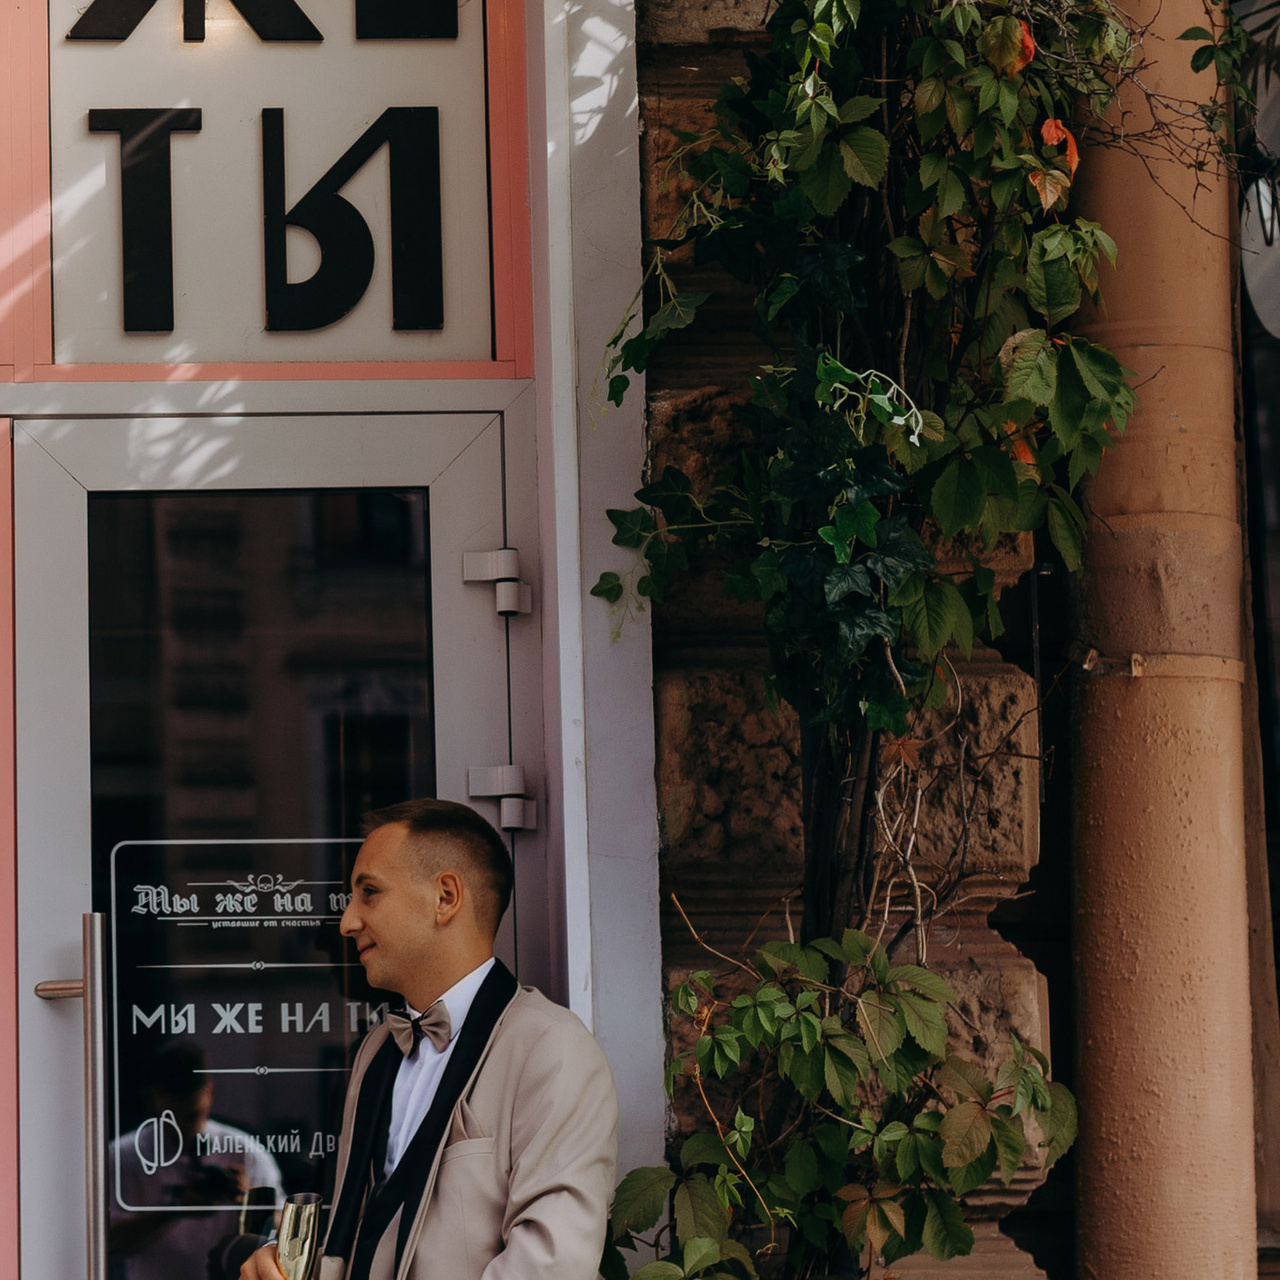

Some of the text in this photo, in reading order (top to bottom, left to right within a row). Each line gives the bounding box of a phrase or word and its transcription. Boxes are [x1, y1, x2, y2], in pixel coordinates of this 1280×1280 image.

[87, 106, 445, 333] ТЫ
[215, 892, 258, 913] же
[273, 892, 314, 913] на
[263, 920, 278, 928] от
[211, 1002, 263, 1035] ЖЕ
[281, 1002, 331, 1034] НА
